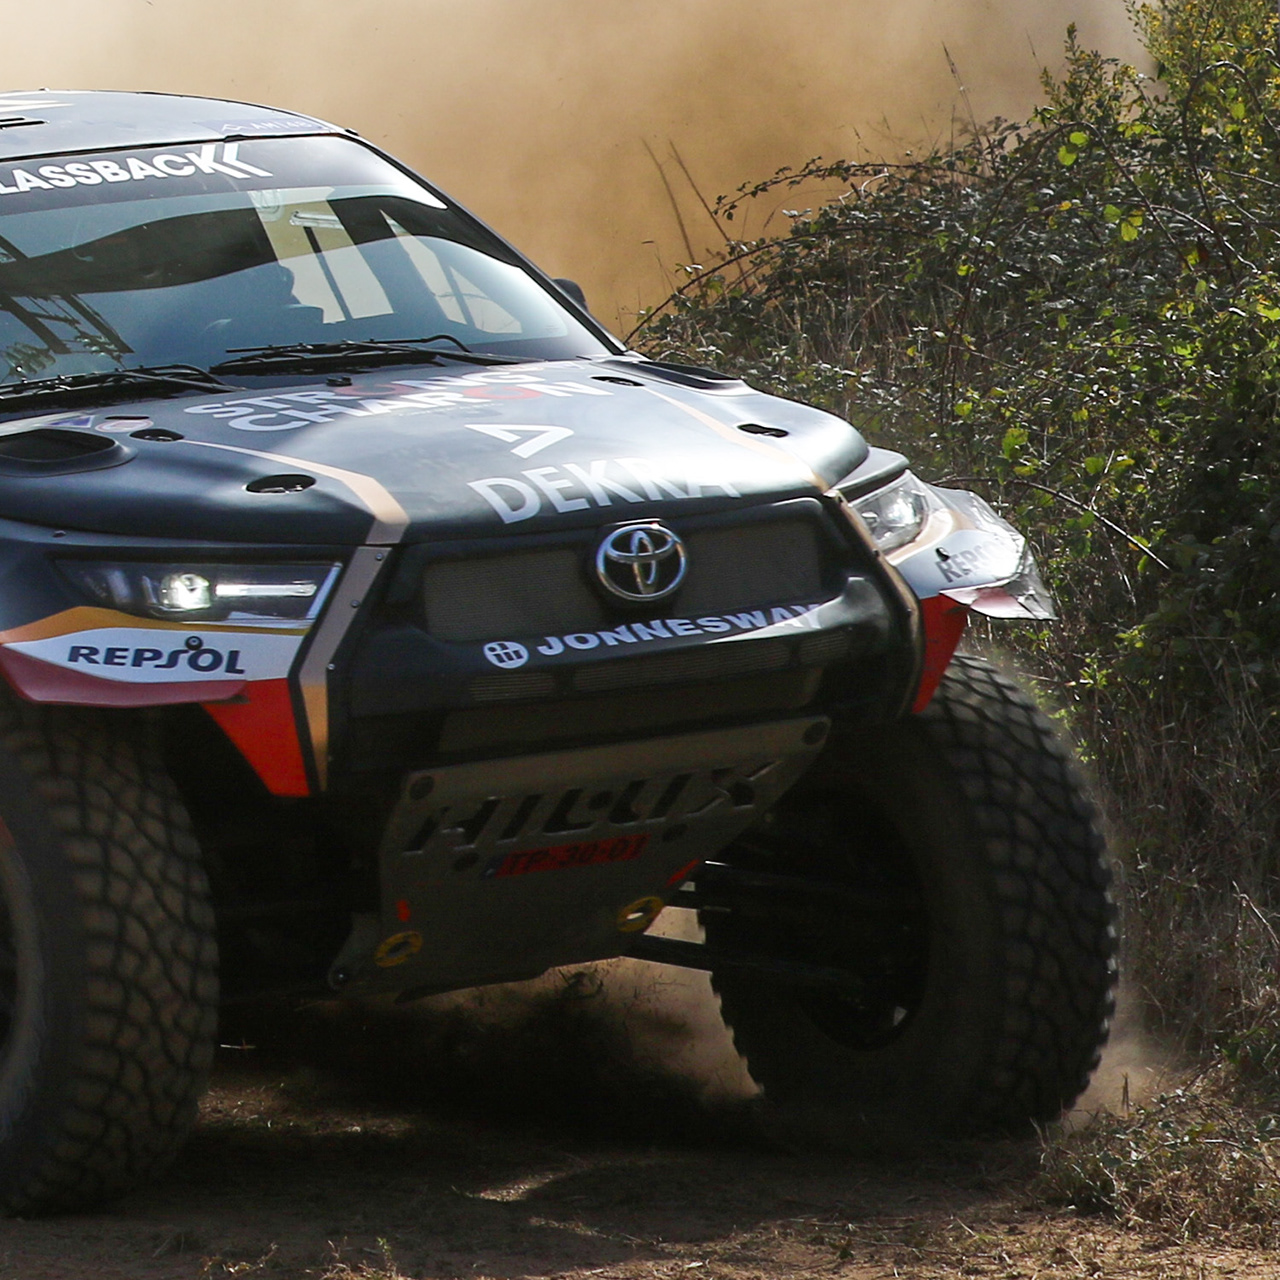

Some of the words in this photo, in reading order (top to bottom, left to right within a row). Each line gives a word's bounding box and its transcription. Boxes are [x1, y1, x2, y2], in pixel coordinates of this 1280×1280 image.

[184, 371, 546, 419] STRONG
[228, 381, 614, 432] CHARON
[537, 604, 821, 656] JONNESWAY
[68, 646, 245, 674] REPSOL
